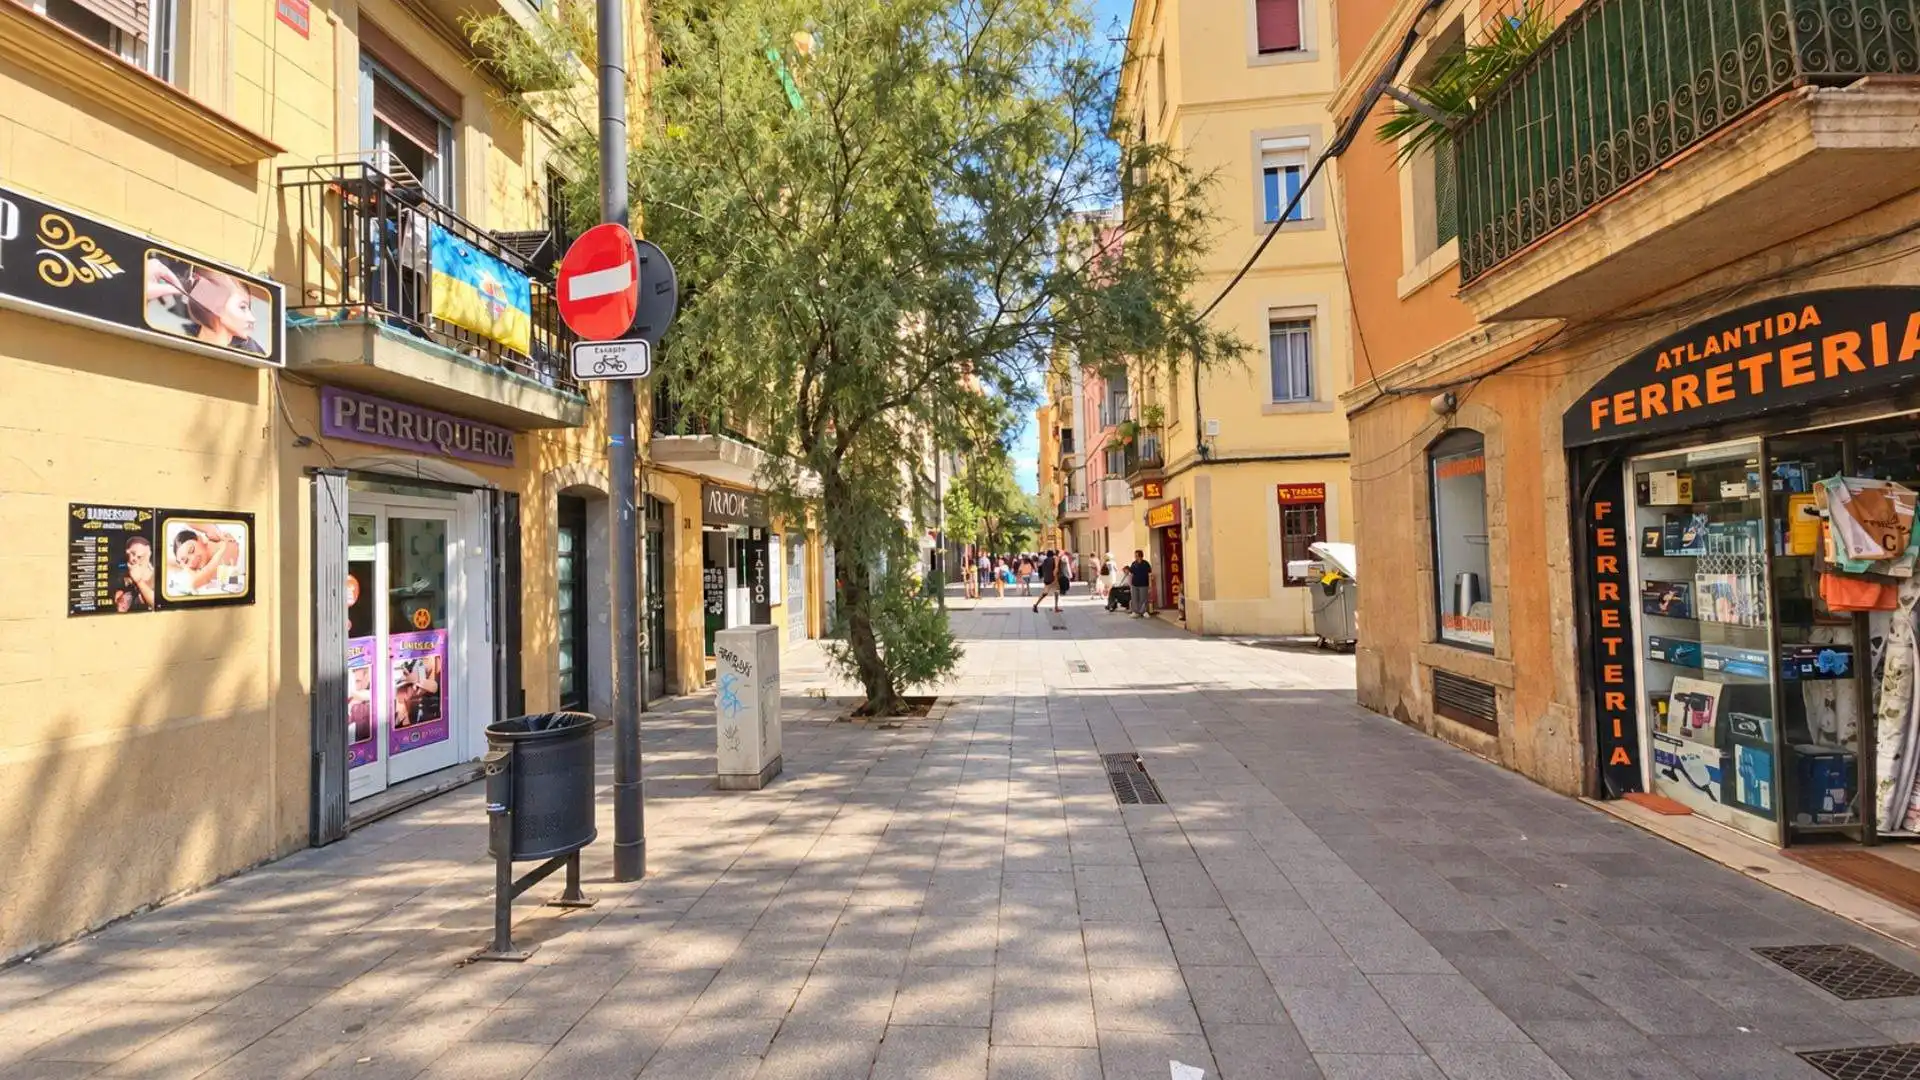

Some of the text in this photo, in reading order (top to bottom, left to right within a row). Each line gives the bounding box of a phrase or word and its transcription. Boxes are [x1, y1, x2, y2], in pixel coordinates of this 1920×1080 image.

[1655, 304, 1822, 373] ATLANTIDA
[333, 396, 515, 457] PERRUQUERIA
[755, 549, 765, 603] TATTOO
[1595, 502, 1631, 765] FERRETERIA
